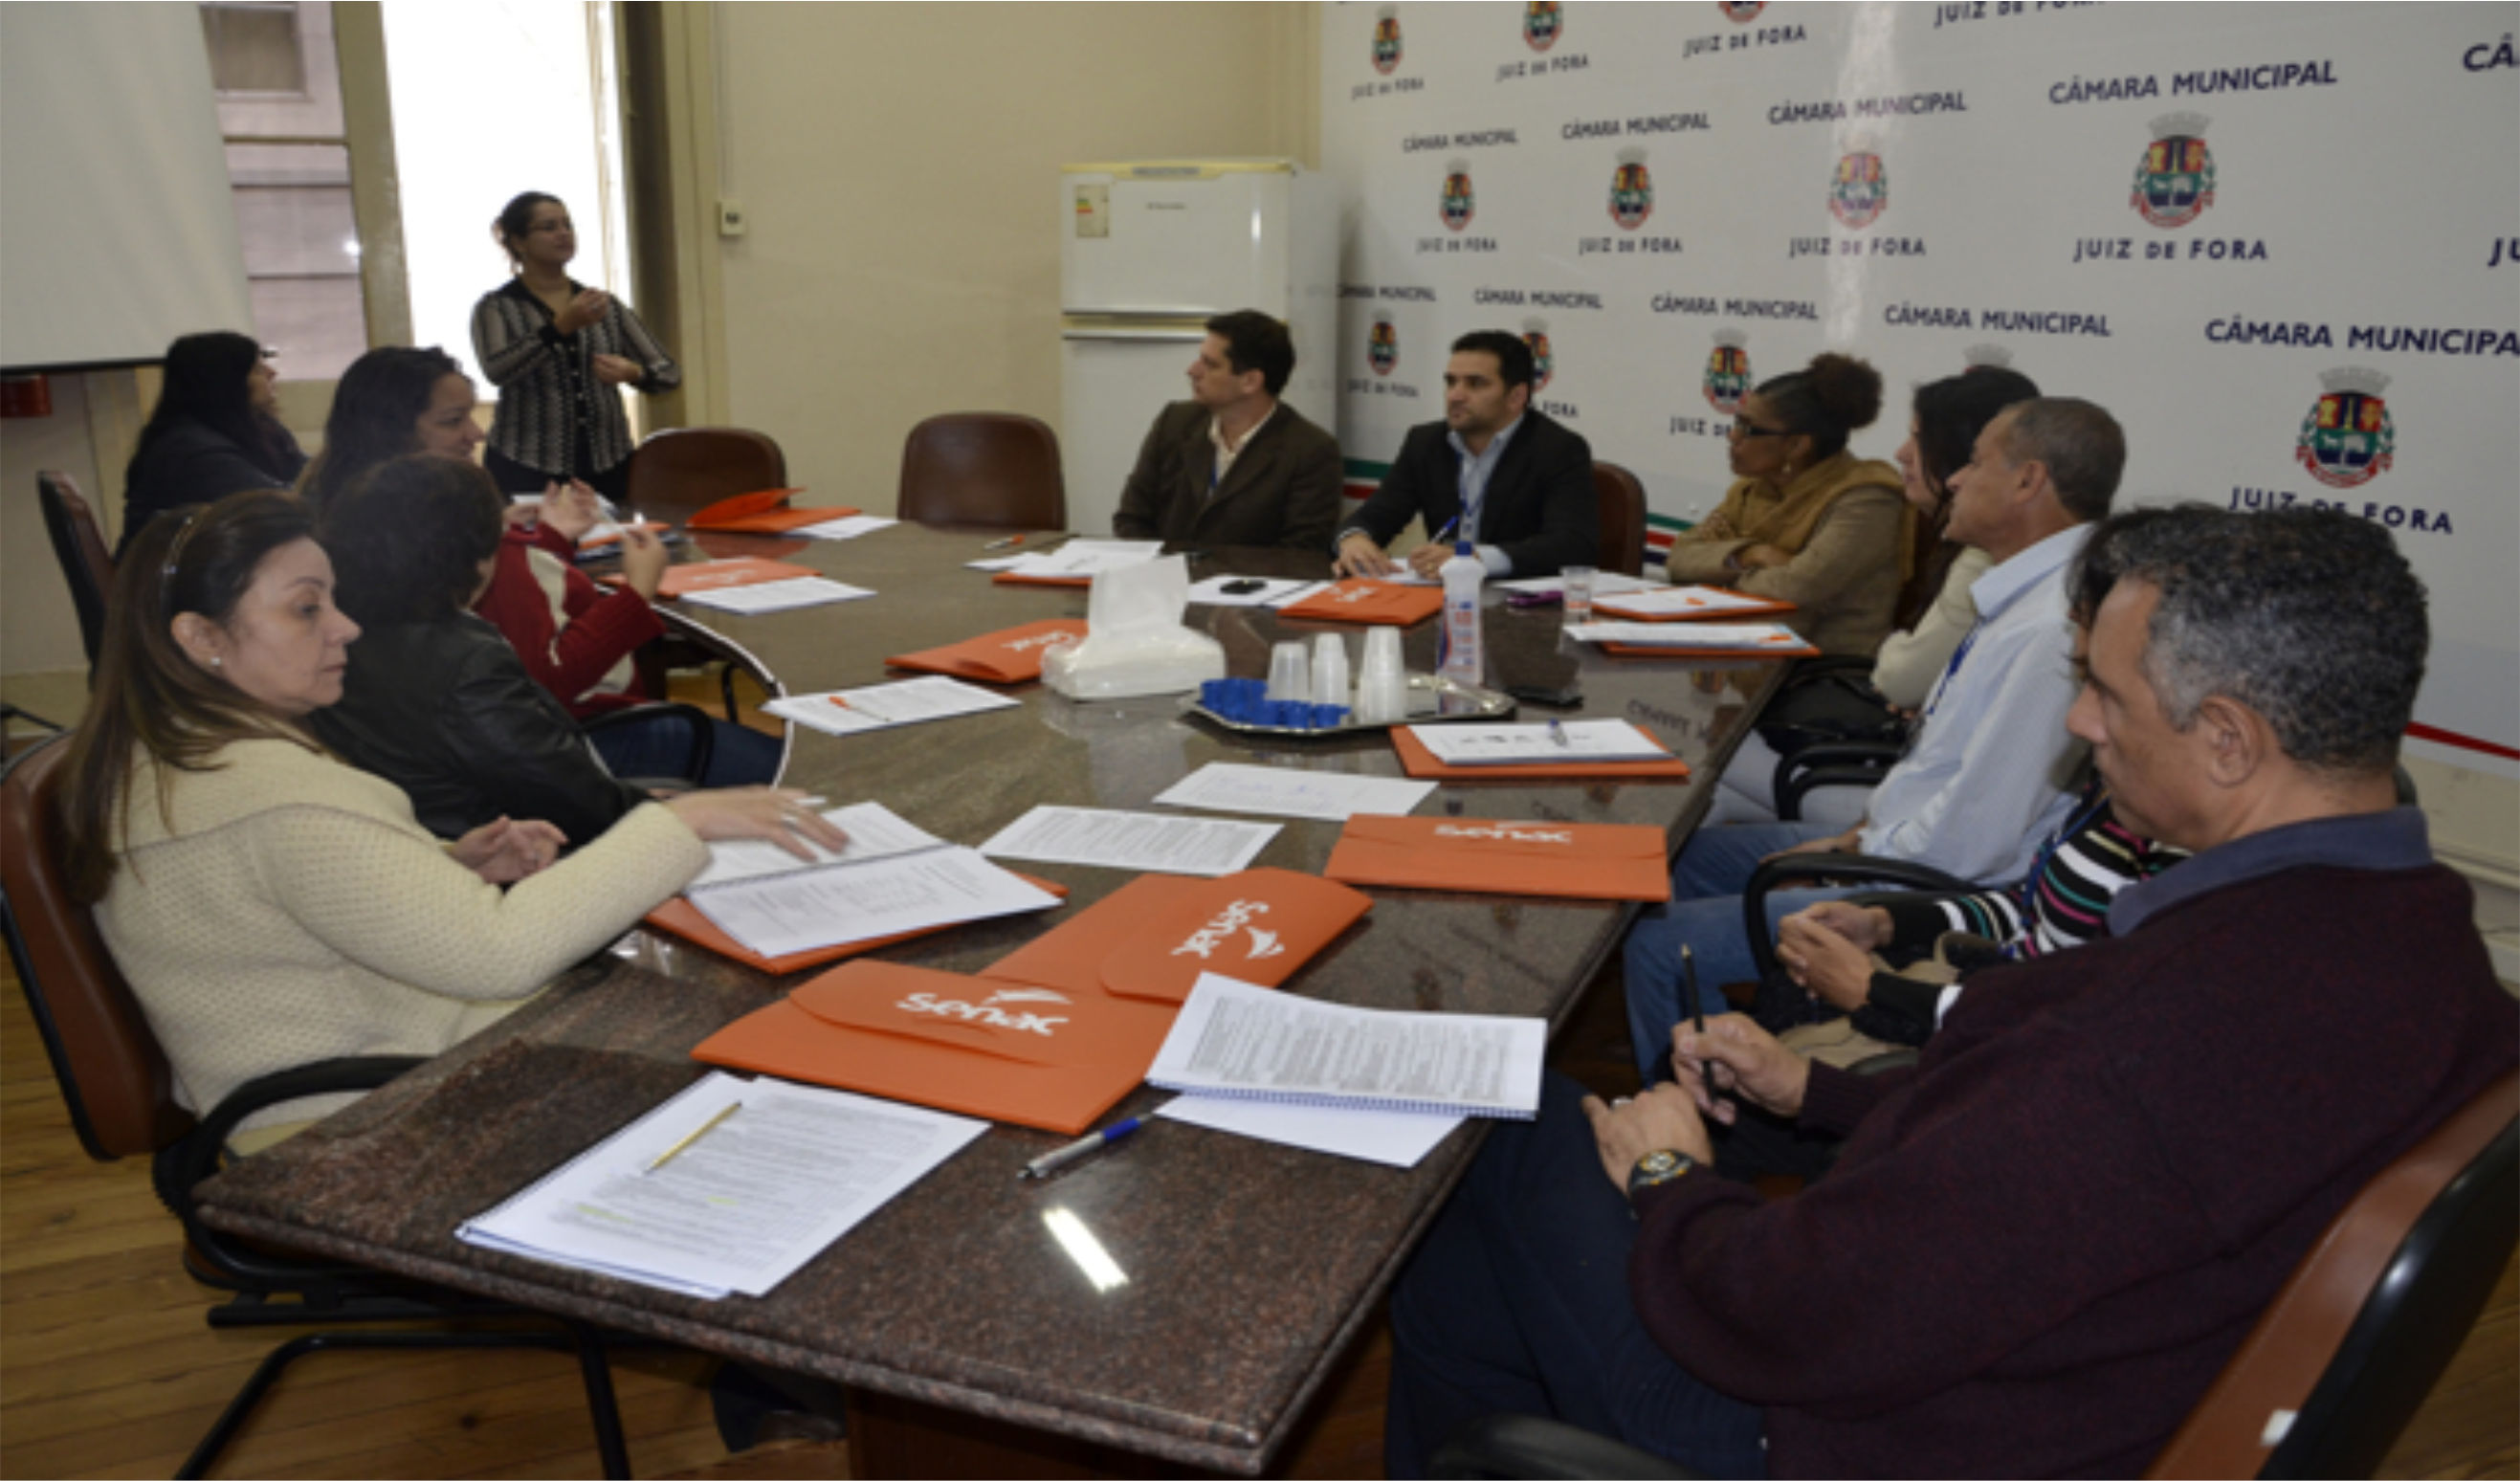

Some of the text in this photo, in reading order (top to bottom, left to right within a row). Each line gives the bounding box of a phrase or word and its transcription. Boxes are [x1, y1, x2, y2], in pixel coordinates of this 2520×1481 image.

[1757, 25, 1806, 45] FORA
[2464, 33, 2520, 72] CÂ
[2049, 60, 2338, 104] CÂMARA MUNICIPAL
[1854, 91, 1967, 119] MUNICIPAL
[1789, 237, 1831, 258] JUIZ
[1871, 236, 1927, 256] FORA
[2072, 238, 2268, 263] JUIZ DE FORA
[1725, 299, 1820, 321] MUNICIPAL
[1981, 309, 2111, 337] MUNICIPAL
[2204, 314, 2520, 357] CÂMARA MUNICIPA
[2363, 501, 2453, 535] FORA
